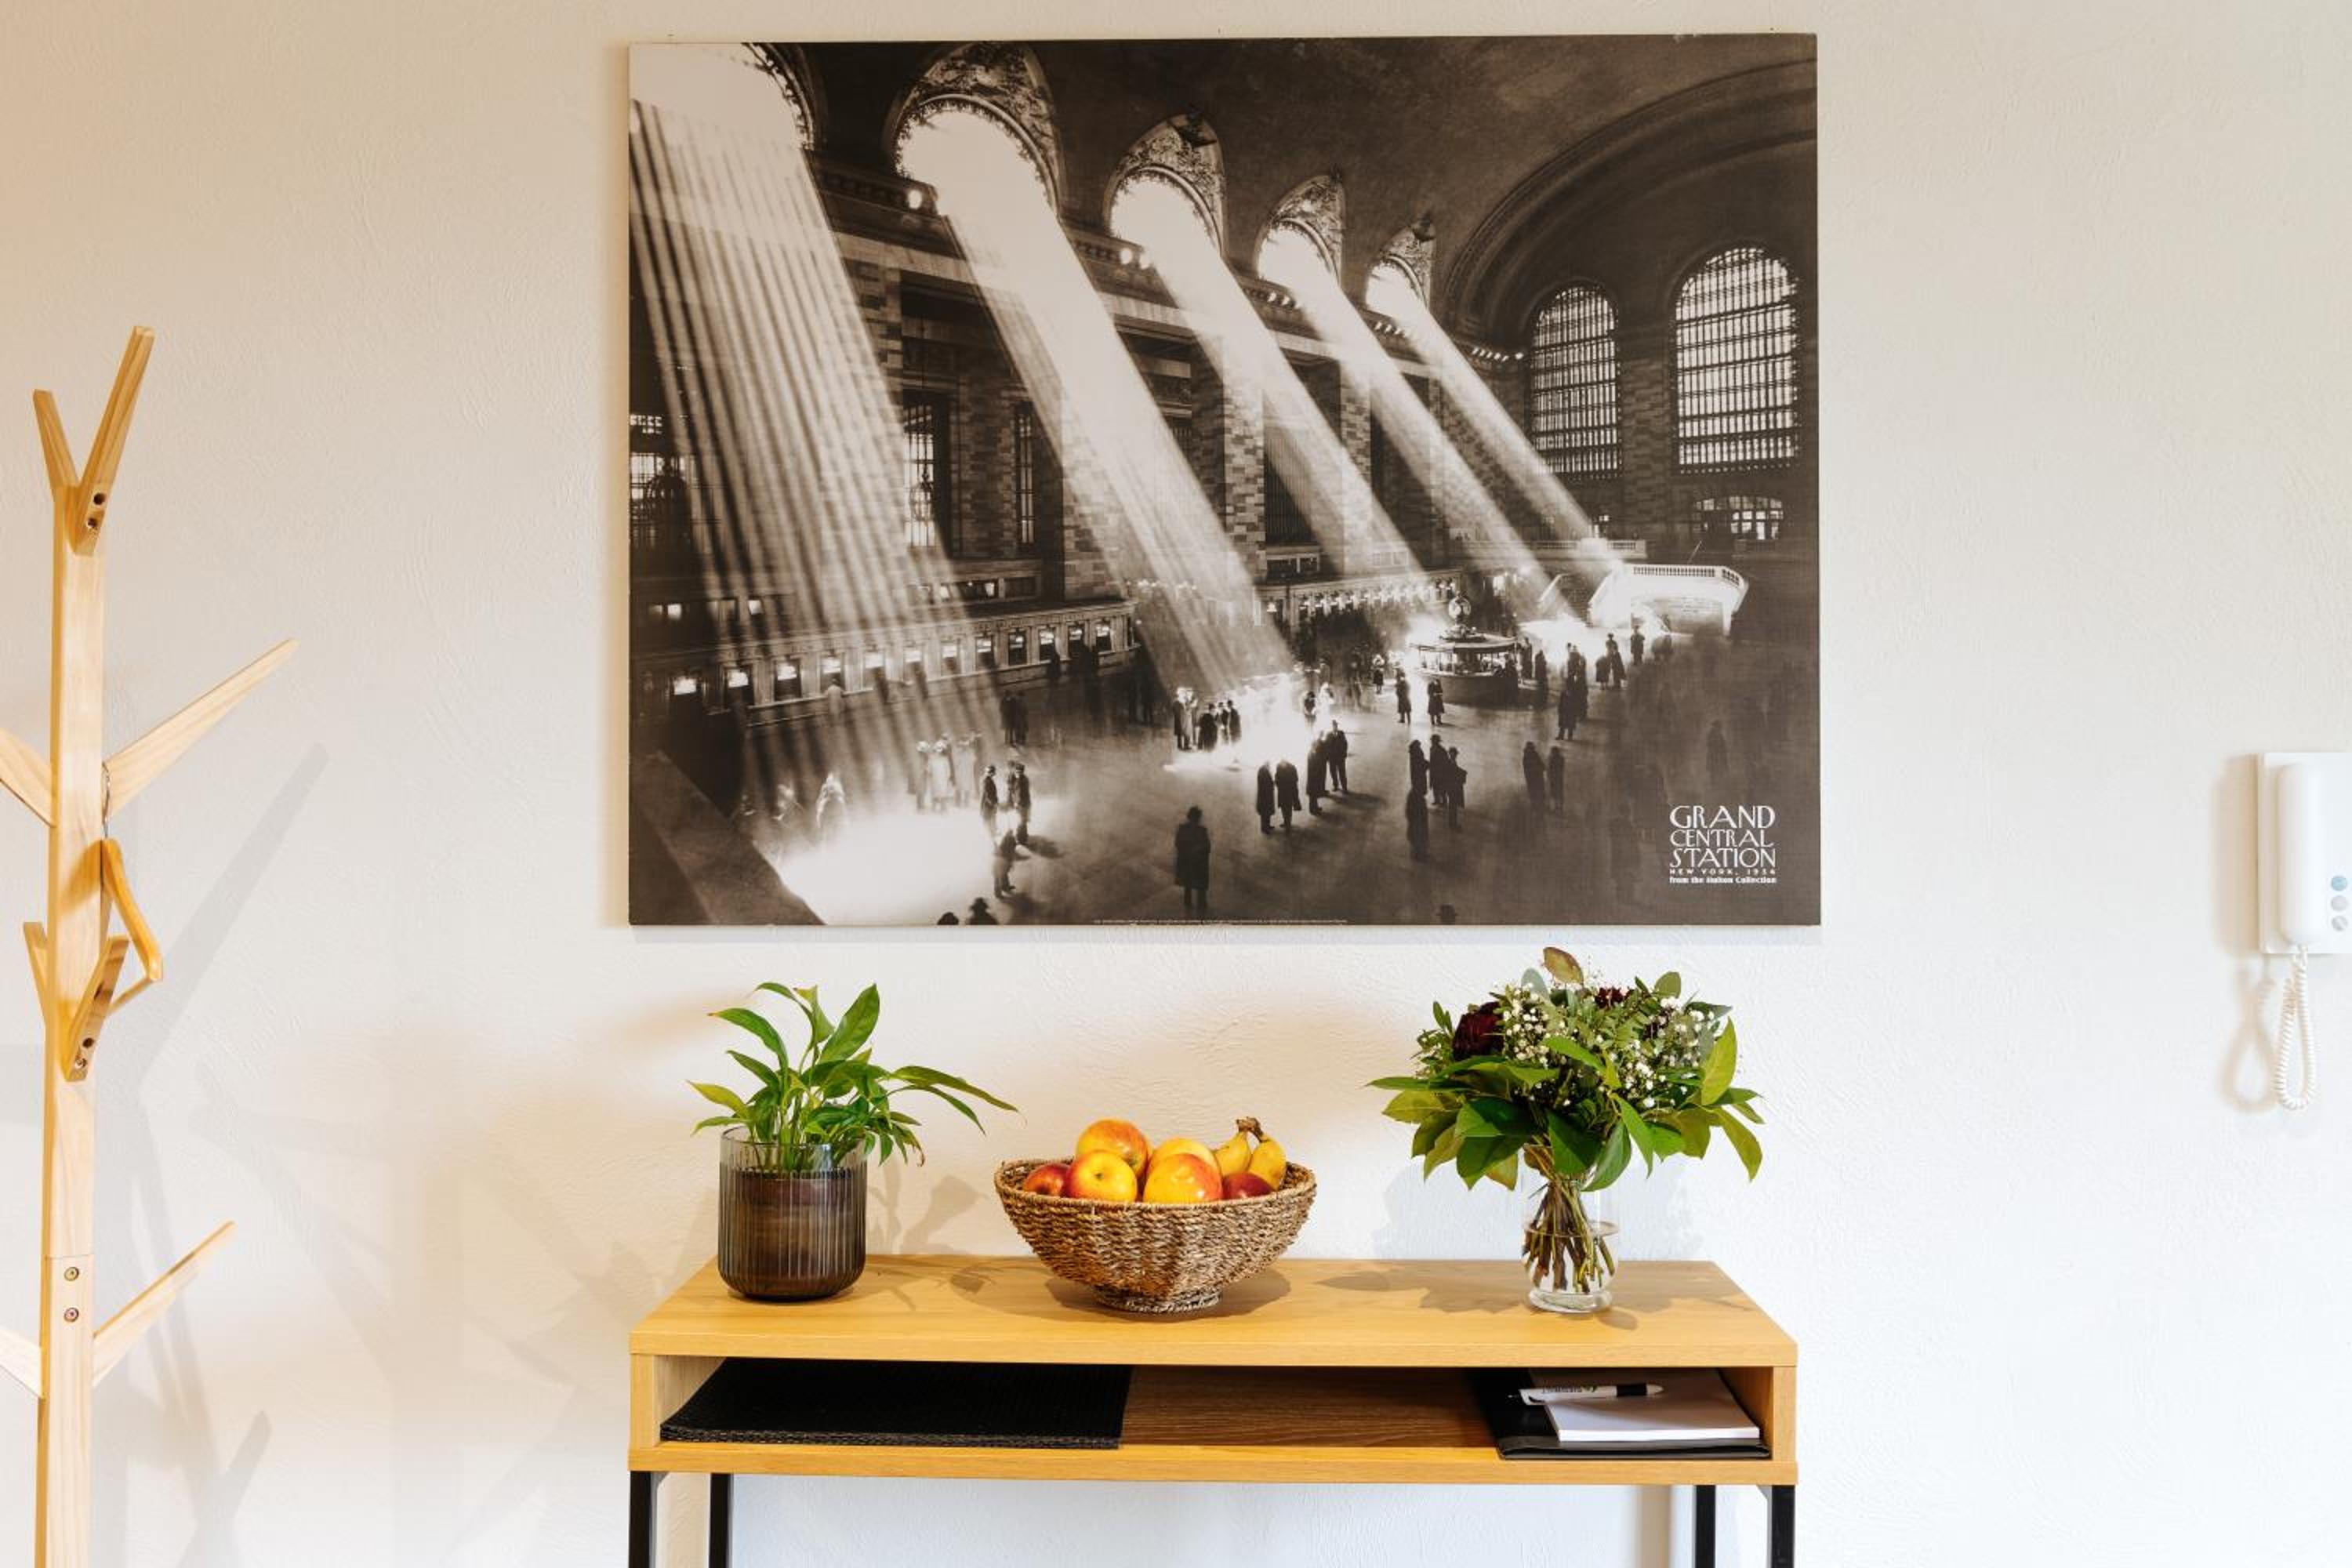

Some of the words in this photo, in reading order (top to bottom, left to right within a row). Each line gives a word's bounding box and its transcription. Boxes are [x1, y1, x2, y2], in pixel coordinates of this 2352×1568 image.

[1669, 805, 1776, 828] GRAND
[1669, 829, 1774, 847] CENTRAL
[1669, 848, 1776, 868] STATION
